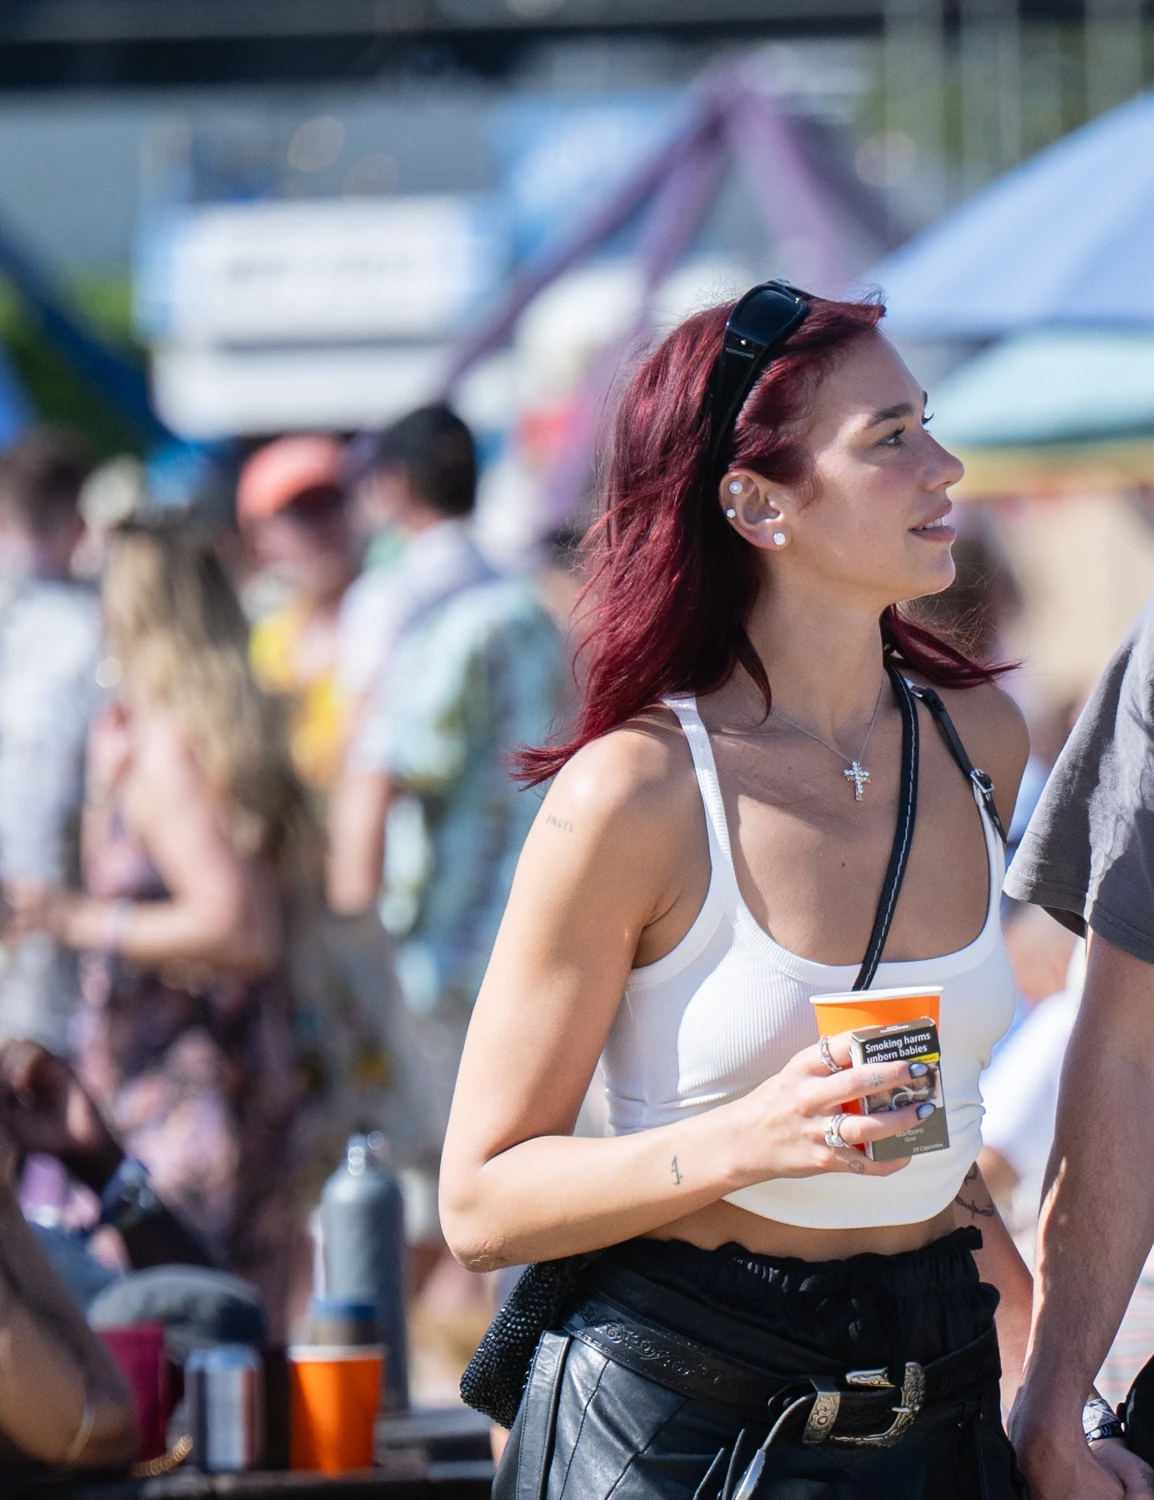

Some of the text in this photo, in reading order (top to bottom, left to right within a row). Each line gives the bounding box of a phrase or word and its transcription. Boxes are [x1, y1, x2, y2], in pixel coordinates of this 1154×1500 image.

[865, 1032, 932, 1054] Smoking harms
[866, 1044, 928, 1064] unborn babies
